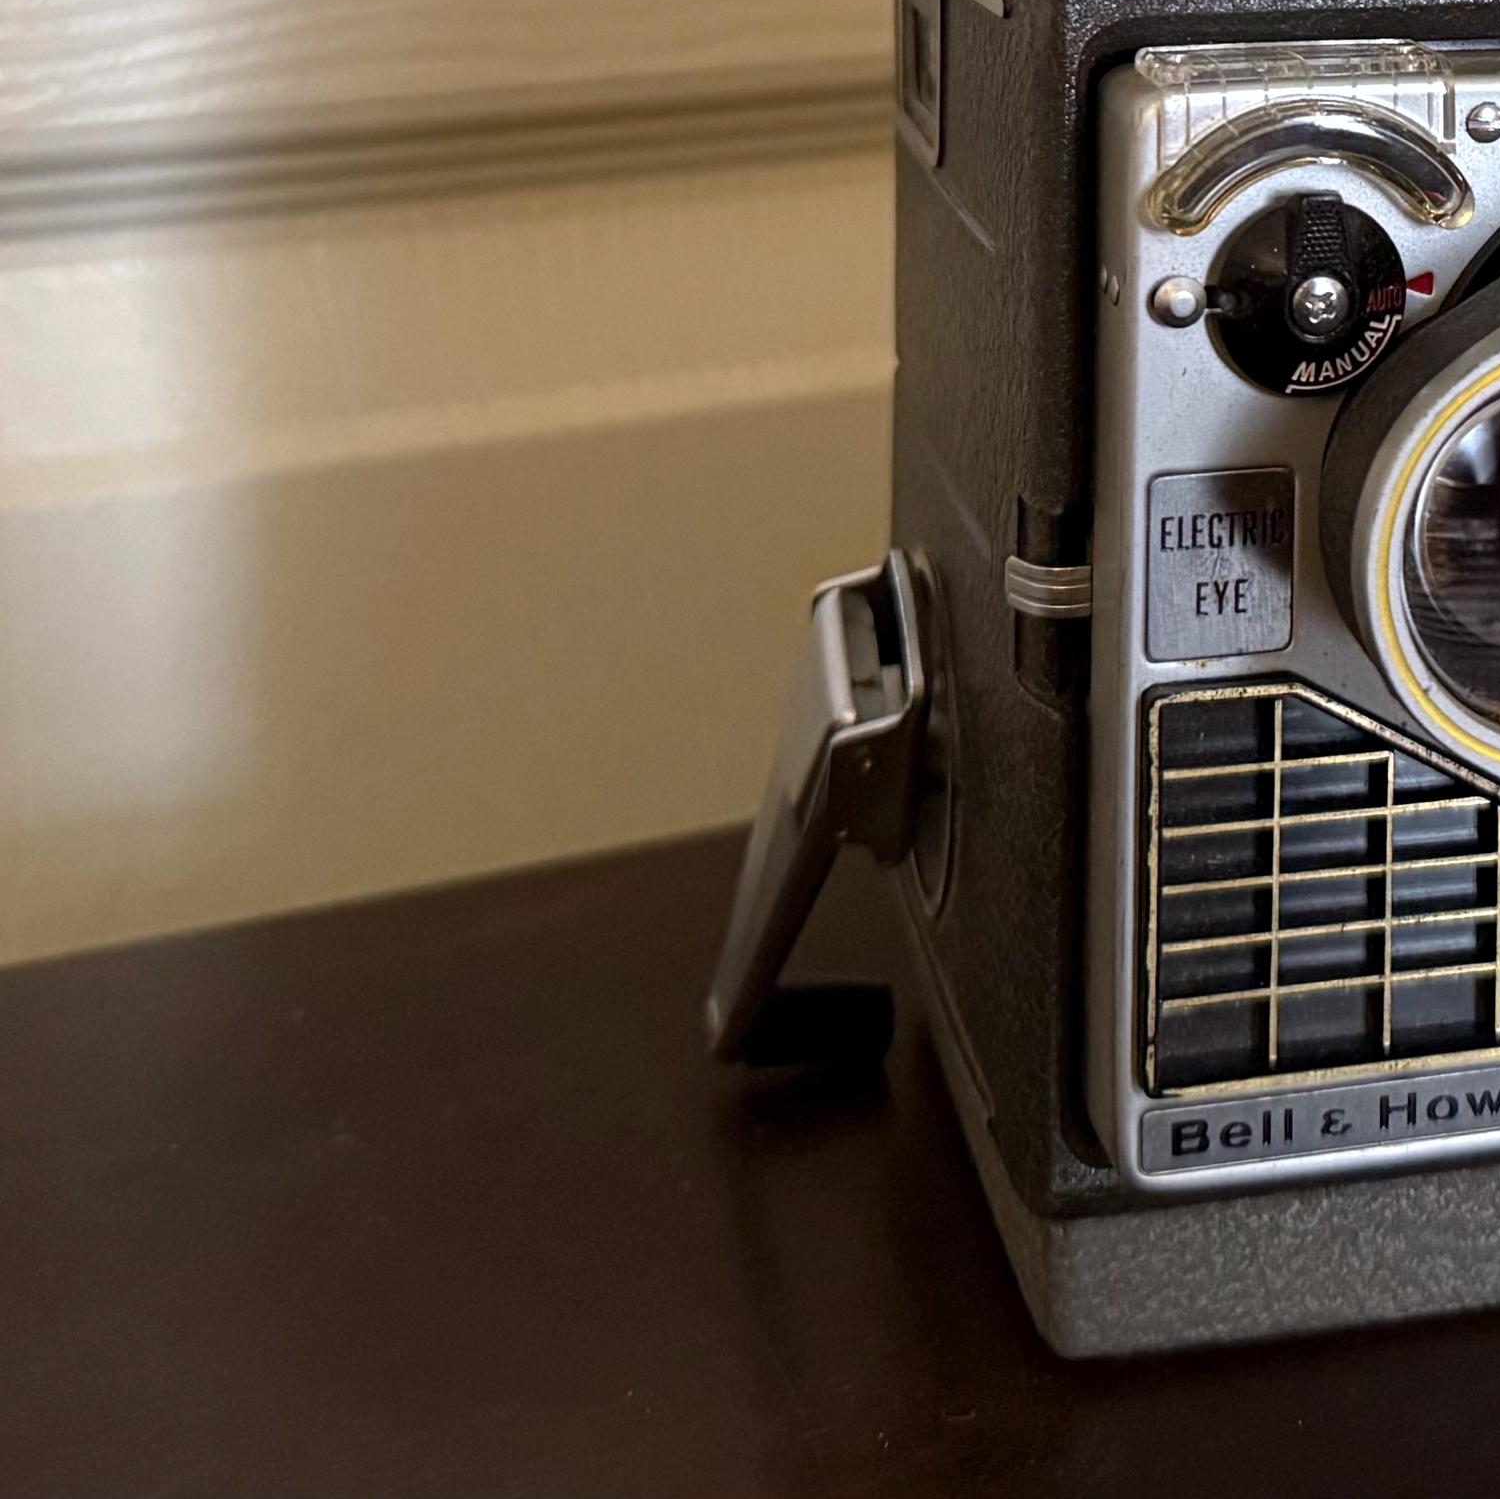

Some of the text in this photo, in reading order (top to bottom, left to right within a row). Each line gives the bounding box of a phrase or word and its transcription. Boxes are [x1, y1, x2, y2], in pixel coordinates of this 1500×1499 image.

[1291, 313, 1391, 384] MANUAL
[1159, 508, 1286, 553] ELECTRIC
[1195, 578, 1250, 617] EYE
[1170, 1107, 1294, 1157] Bell
[1320, 1108, 1353, 1138] &
